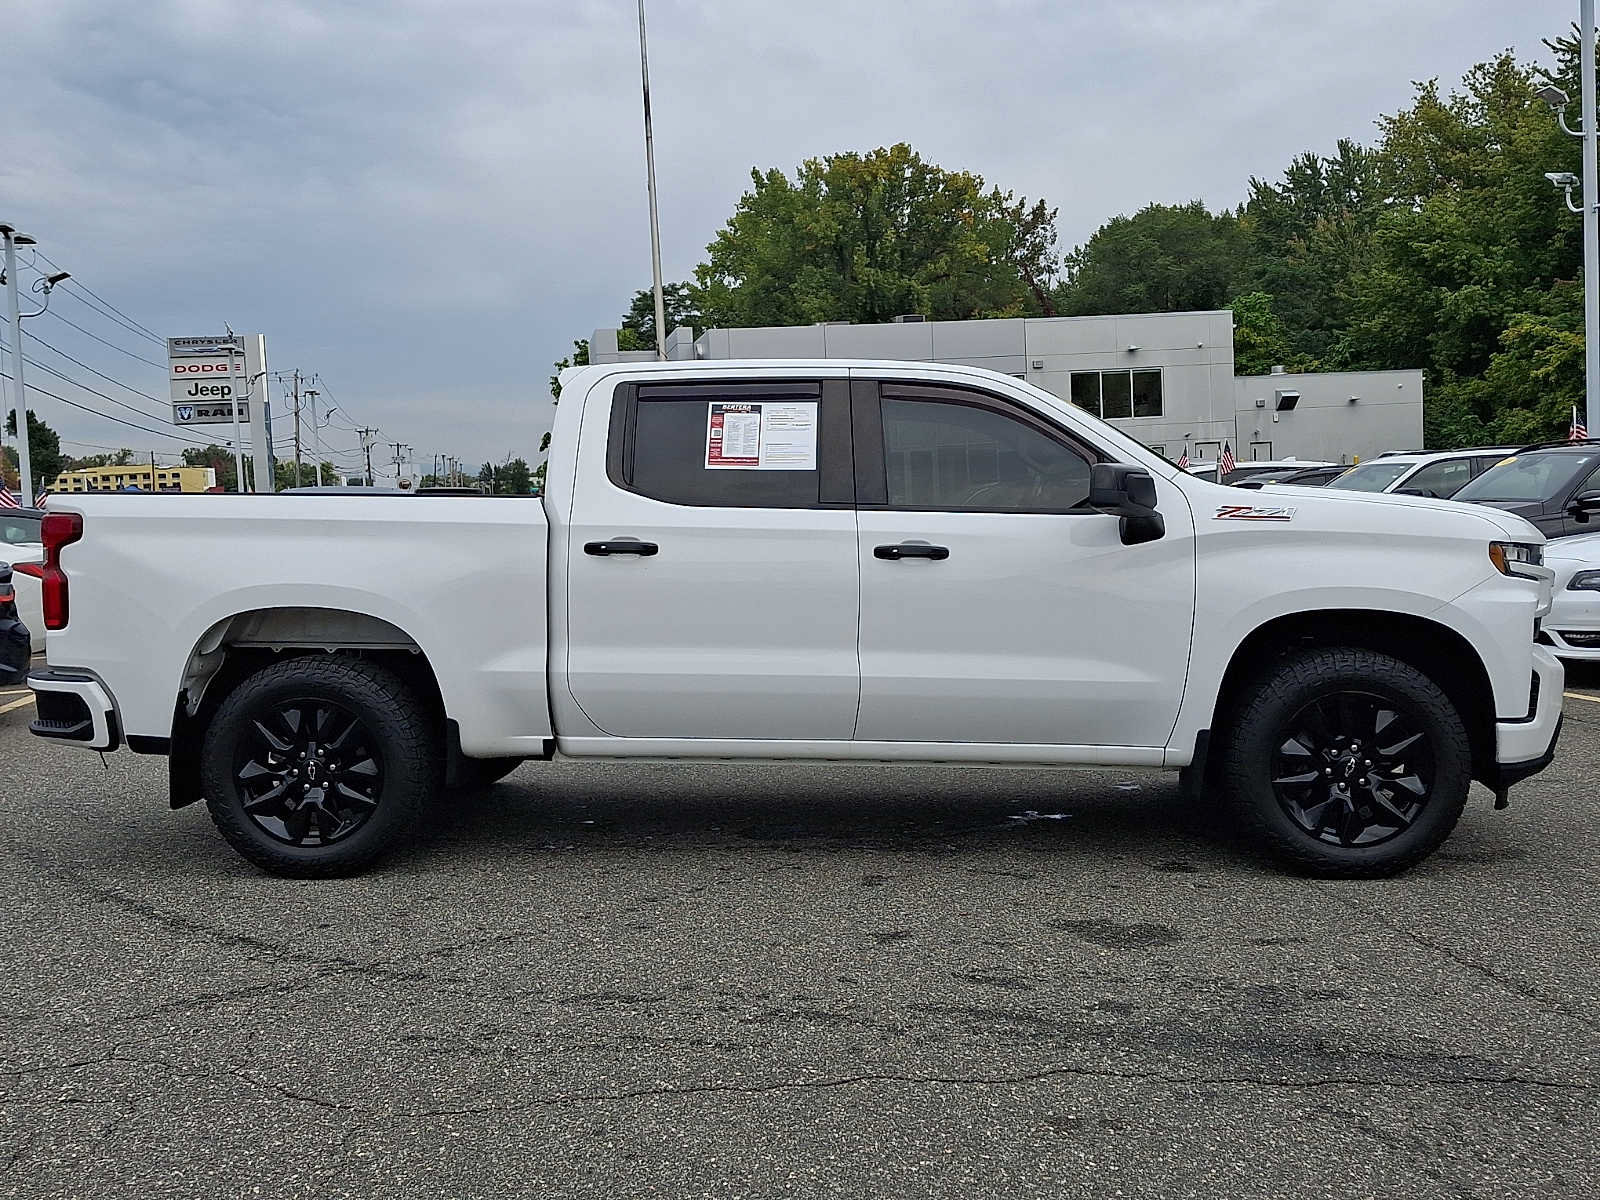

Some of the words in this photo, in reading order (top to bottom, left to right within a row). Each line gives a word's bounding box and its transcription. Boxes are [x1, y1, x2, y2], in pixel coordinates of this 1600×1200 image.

[174, 363, 241, 374] DODGE
[187, 382, 232, 398] Jeep
[1215, 504, 1297, 521] Z71
